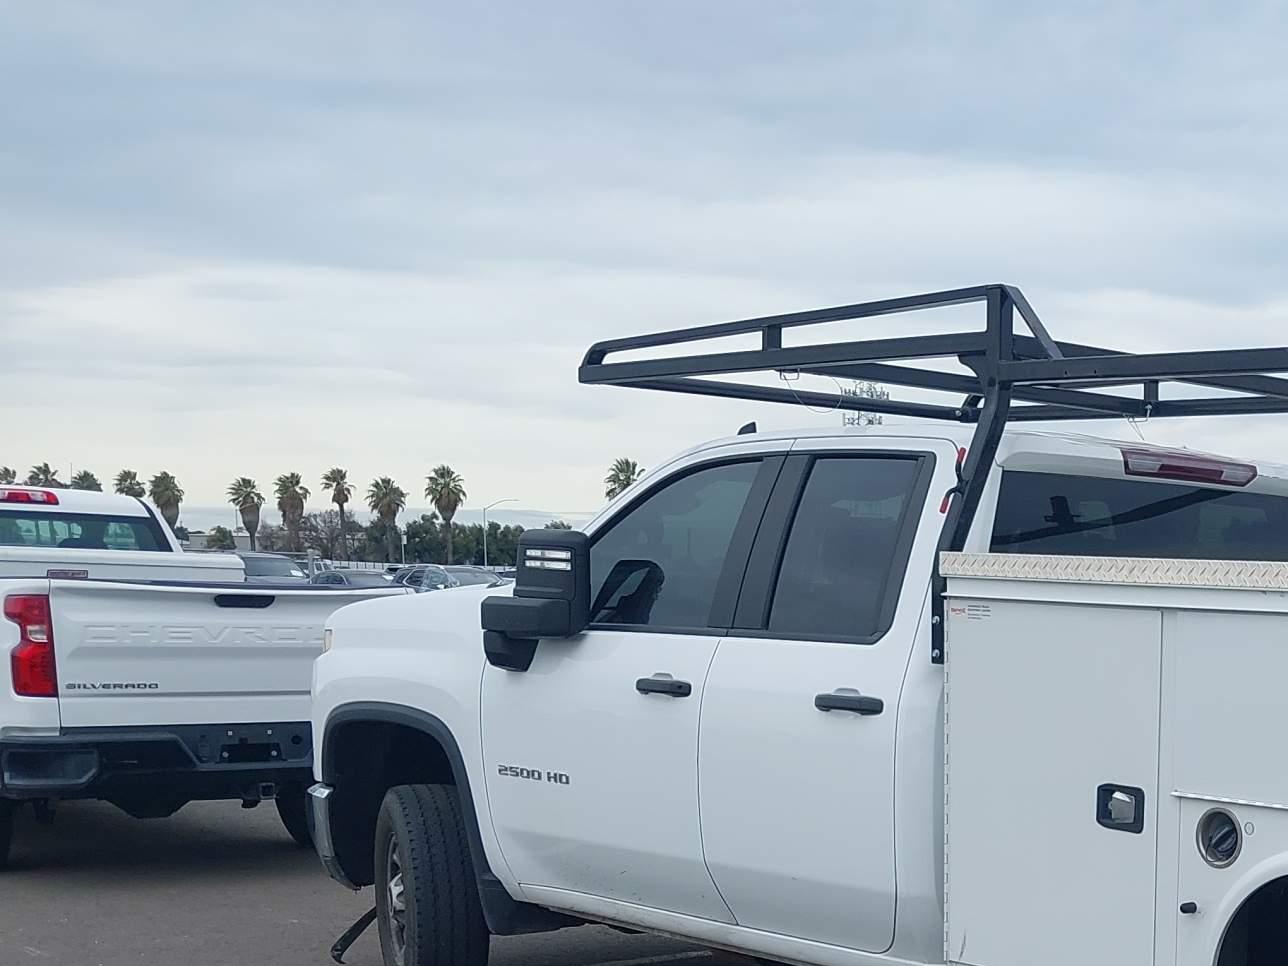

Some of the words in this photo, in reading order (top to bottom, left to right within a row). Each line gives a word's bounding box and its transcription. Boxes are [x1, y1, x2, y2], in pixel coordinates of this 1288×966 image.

[84, 625, 325, 643] CHEVROL
[65, 682, 159, 690] SILVERADO
[497, 764, 542, 781] 2500
[546, 771, 570, 785] HD
